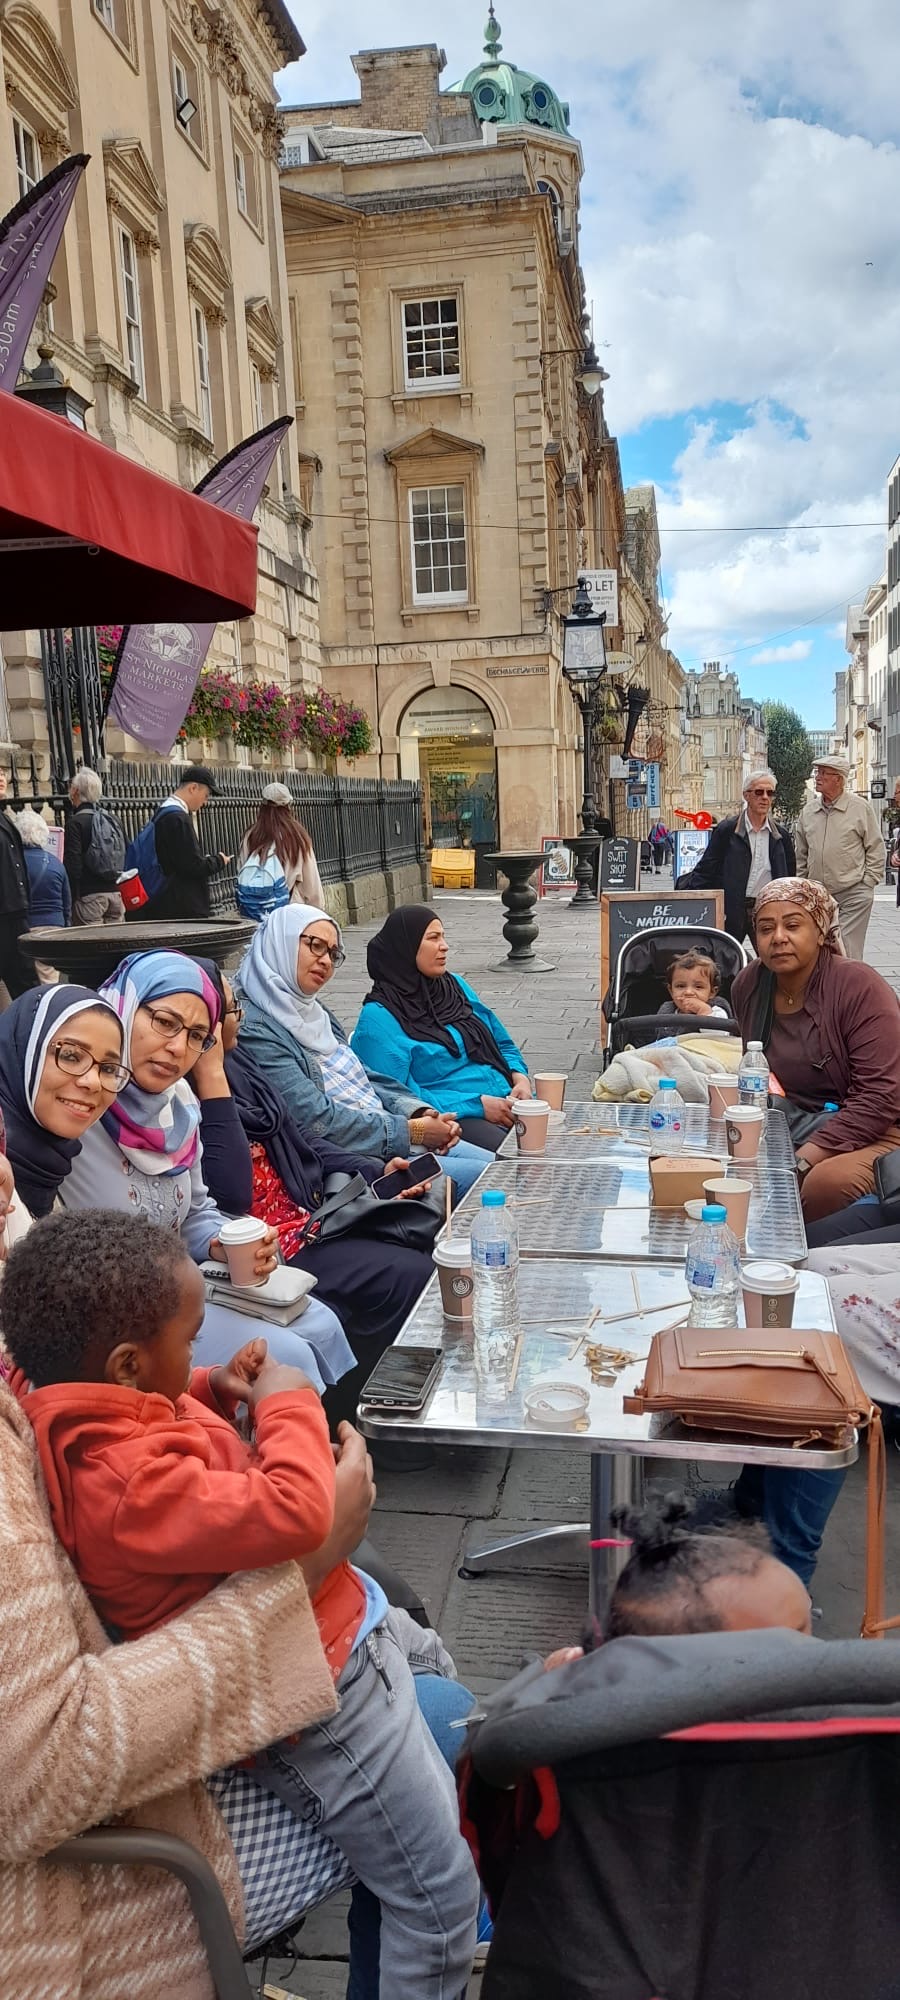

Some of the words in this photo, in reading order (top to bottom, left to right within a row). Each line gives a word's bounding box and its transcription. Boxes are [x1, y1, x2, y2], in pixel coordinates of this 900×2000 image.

[595, 580, 614, 592] LET
[383, 643, 444, 663] POST
[455, 637, 547, 657] OFFICE
[142, 658, 194, 685] NICHOLAS
[129, 665, 186, 692] MARKETS
[607, 850, 629, 863] SWEET
[609, 864, 627, 875] SHOP
[652, 904, 673, 917] BE
[635, 915, 692, 928] NATURAL
